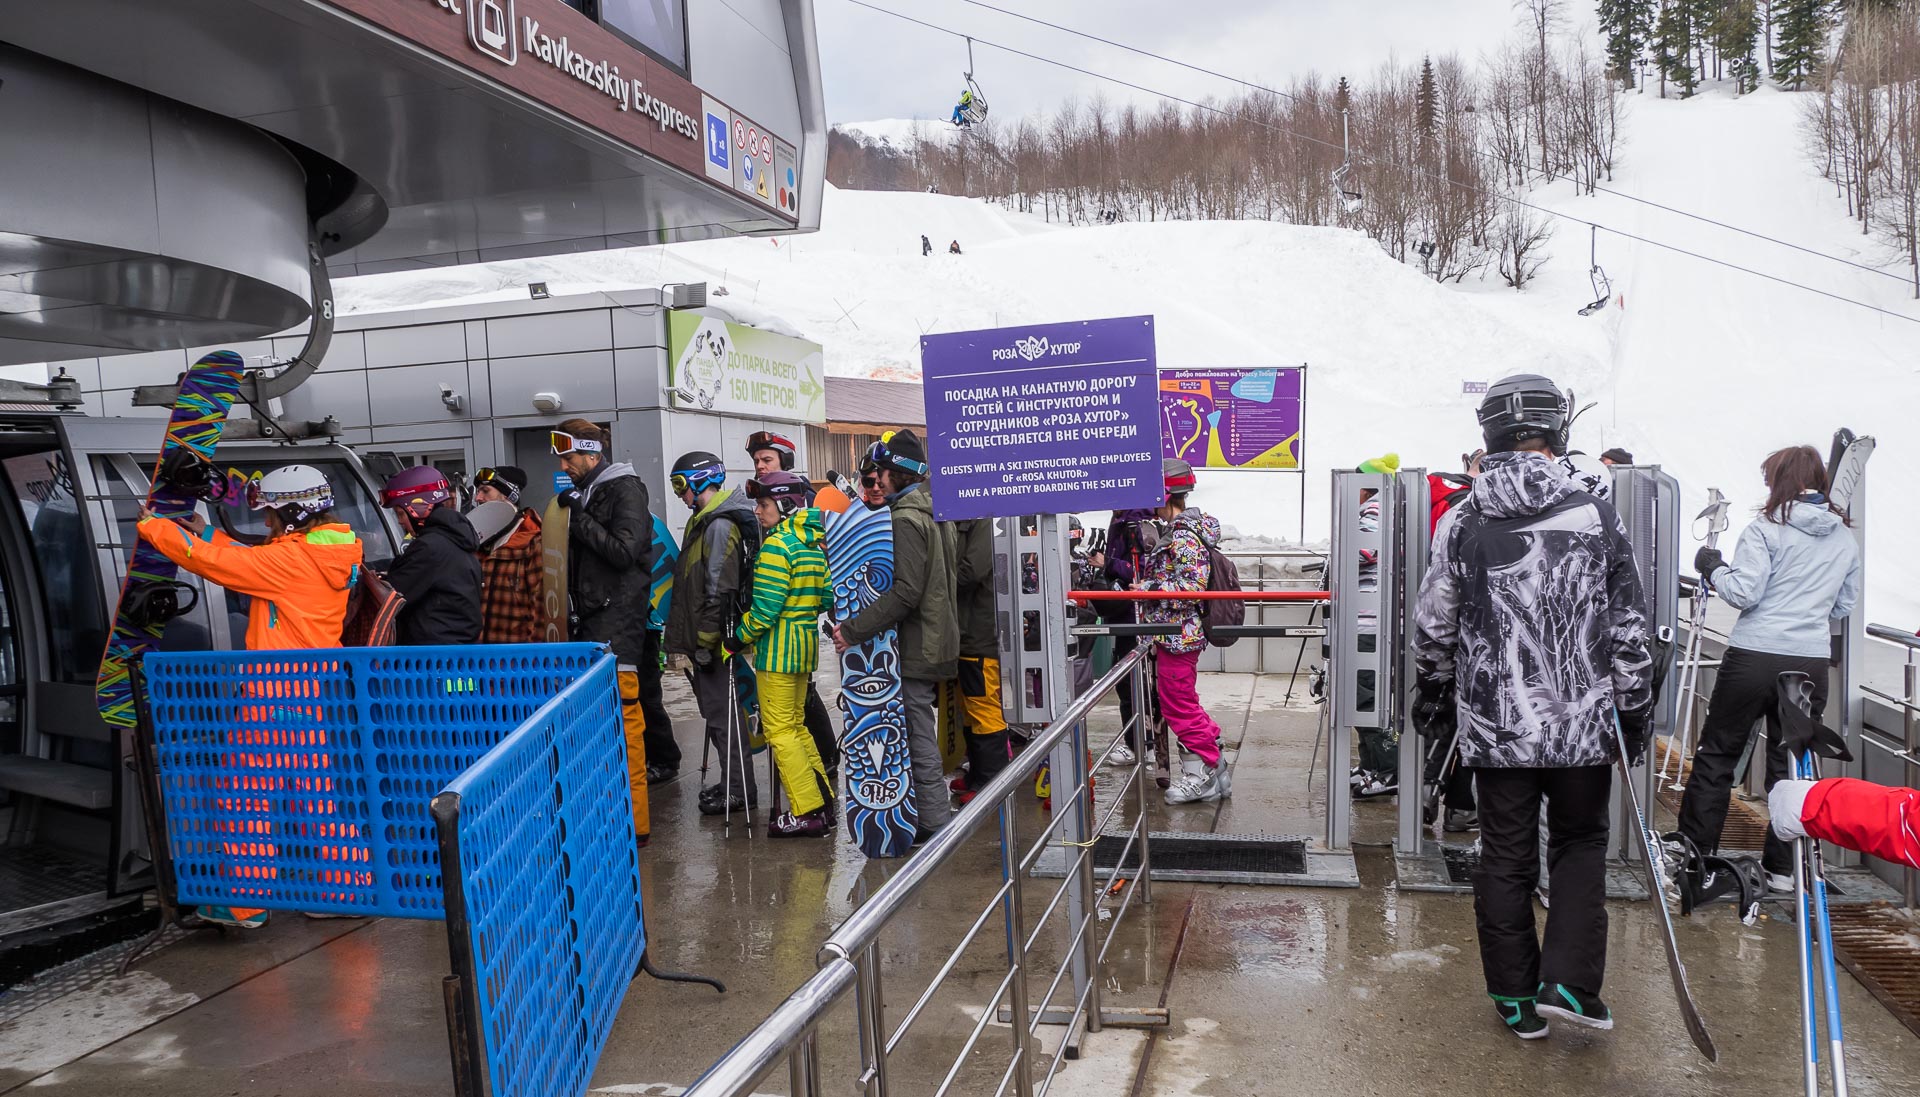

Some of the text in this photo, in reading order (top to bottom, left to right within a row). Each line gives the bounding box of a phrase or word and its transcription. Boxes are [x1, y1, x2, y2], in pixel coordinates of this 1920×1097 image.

[522, 15, 699, 142] Kavkazskiy Exspress
[992, 343, 1081, 360] РОЗА ХУТОР
[728, 351, 798, 380] ДО ПАРКА ВСЕГО
[729, 378, 798, 409] 150 МЕТРОВ!
[945, 376, 1137, 402] ПОСАДКА НА КАНАТНУЮ ДОРОГУ
[962, 394, 1121, 417] ГОСТЕЙ С ИНСТРУКТОРОМ И
[956, 409, 1130, 433] СОТРУДНИКОВ «РОЗА ХУТОР»
[950, 425, 1137, 449] ОСУЩЕСТВЛЯЕТСЯ ВНЕ ОЧЕРЕДИ
[941, 452, 1151, 476] GUESTS WITH A SKI INSTRUCTOR AND EMPLOYEES
[1002, 469, 1089, 483] OF «ROSA KHUTOR»
[958, 478, 1136, 498] HAVE A PRIORITY BOARDING THE SKI LIFT
[545, 543, 564, 642] free
[946, 680, 956, 756] UILDERS
